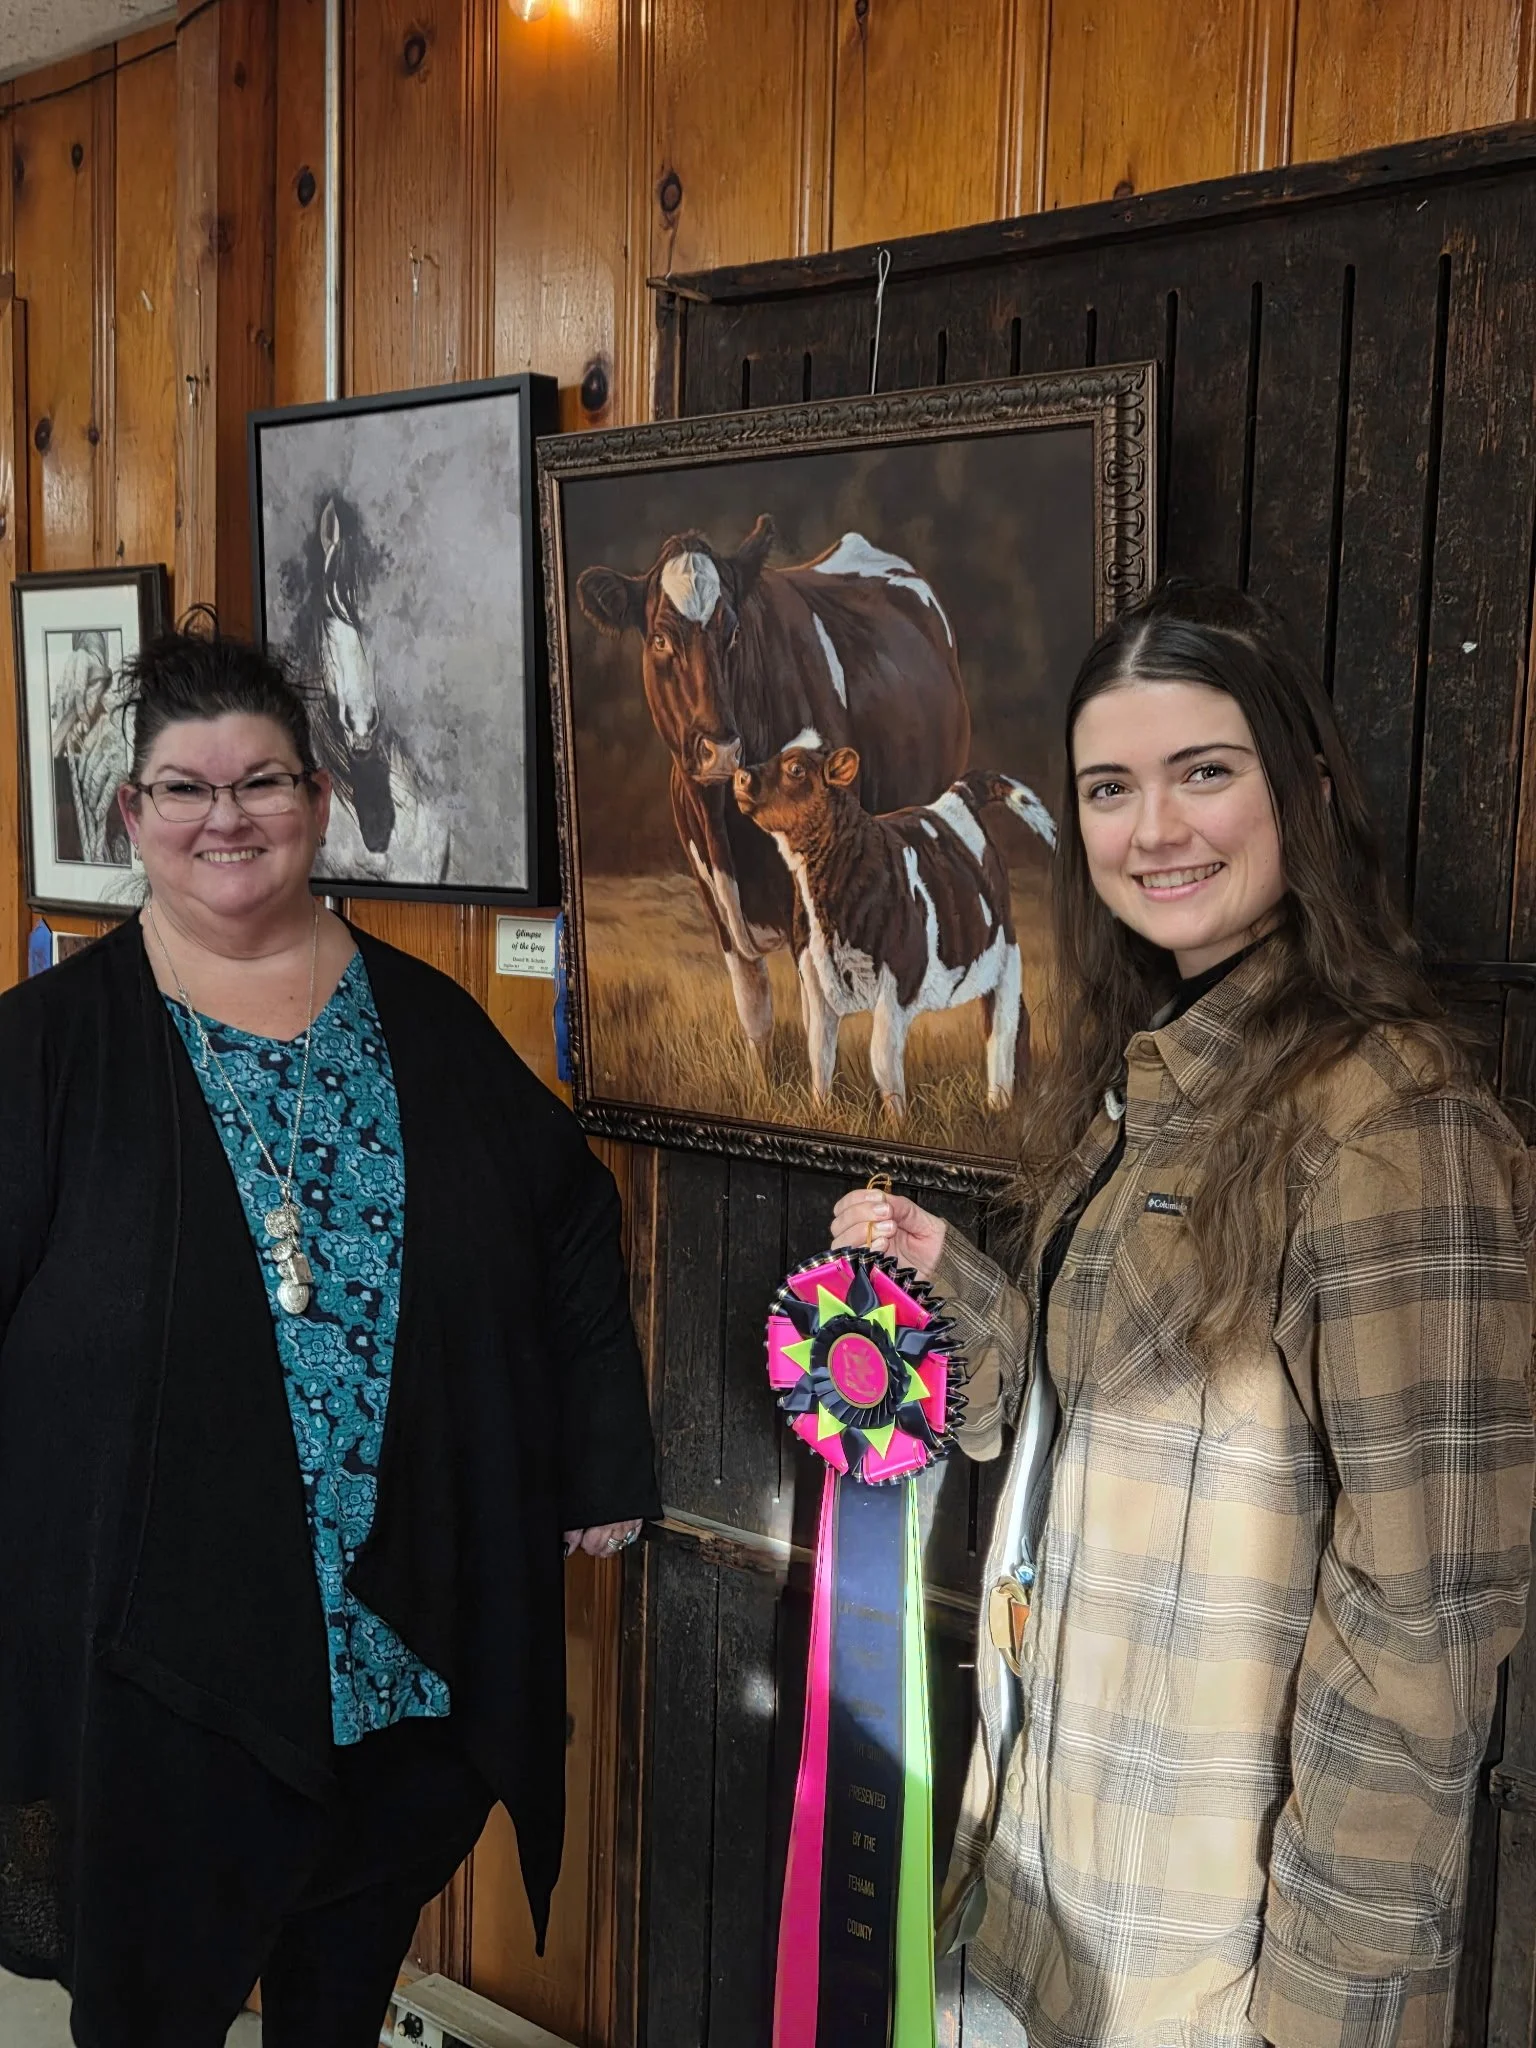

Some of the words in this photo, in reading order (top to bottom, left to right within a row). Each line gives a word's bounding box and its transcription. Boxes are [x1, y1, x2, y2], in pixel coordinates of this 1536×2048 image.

[516, 929, 541, 939] Glimpse
[512, 942, 518, 951] of
[519, 942, 529, 950] the
[848, 1784, 886, 1810] PRESENTED
[852, 1831, 861, 1847] BY
[863, 1834, 876, 1853] THE
[848, 1873, 875, 1898] TEHAMA
[847, 1918, 873, 1942] COUNTY
